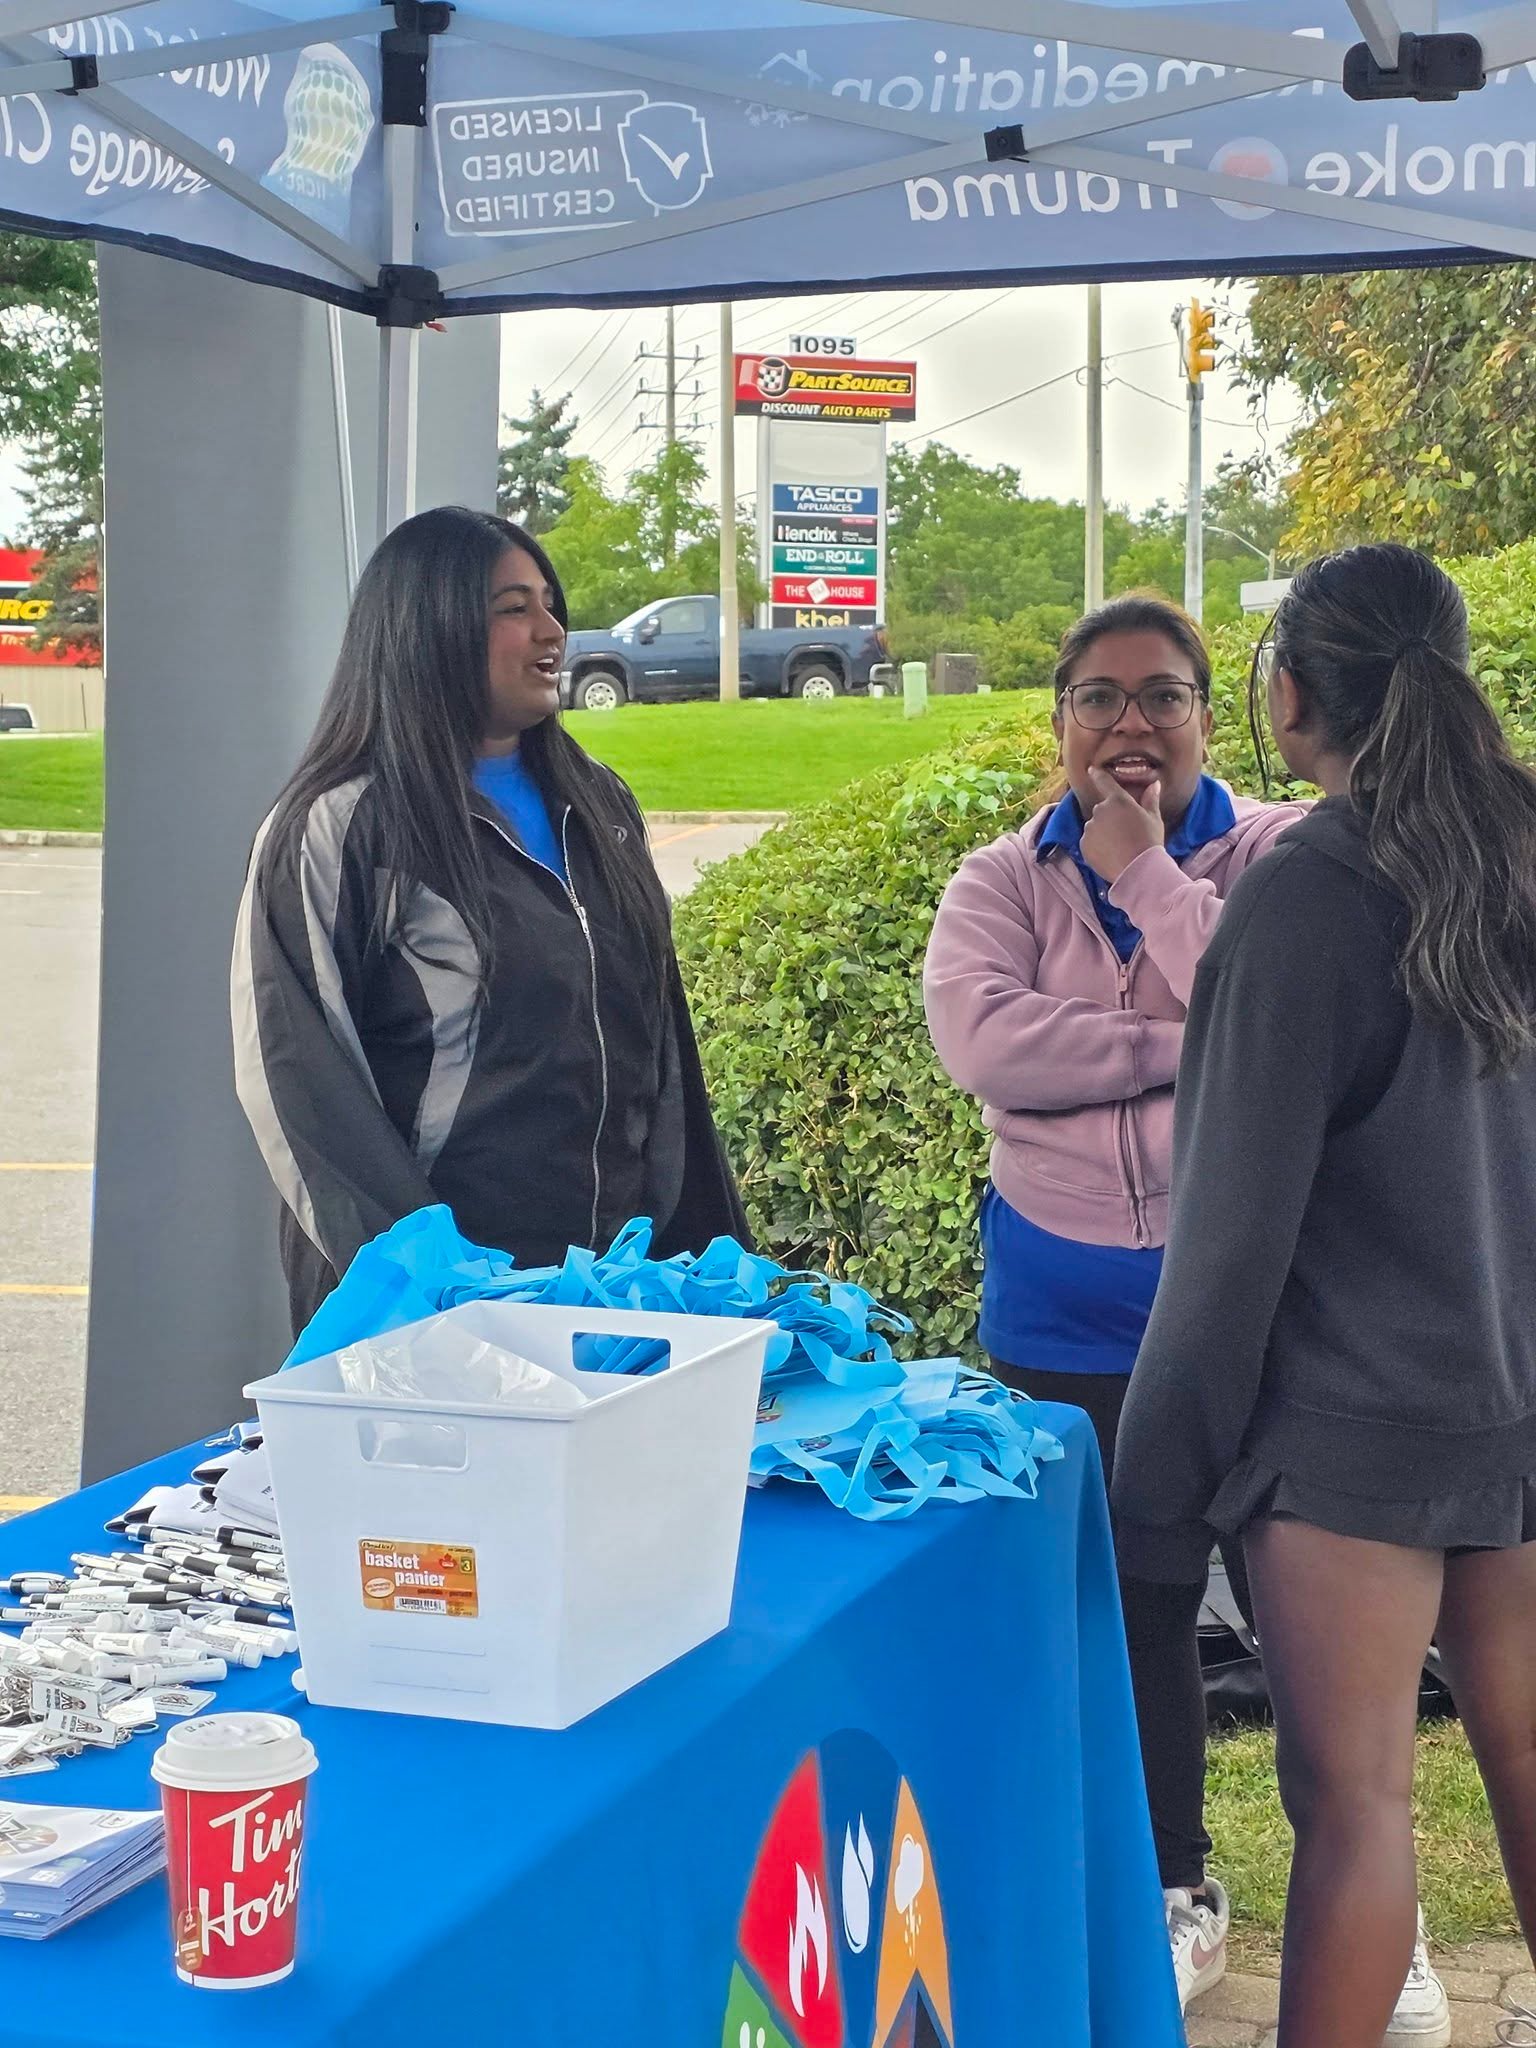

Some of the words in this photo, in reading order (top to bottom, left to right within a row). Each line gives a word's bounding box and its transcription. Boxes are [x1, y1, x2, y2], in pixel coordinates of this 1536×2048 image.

[791, 336, 855, 356] 1095
[761, 402, 821, 415] DISCOUNT
[821, 405, 854, 417] AUTO
[855, 407, 892, 418] PARTS
[788, 486, 863, 504] TASCO
[797, 502, 853, 512] APPLIANCES
[777, 525, 837, 543] Hendrix
[785, 549, 817, 562] END
[825, 550, 865, 564] ROLL
[784, 585, 805, 597] THE
[831, 587, 865, 599] HOUSE
[364, 1550, 420, 1570] basket
[394, 1571, 445, 1587] panier
[208, 1790, 302, 1873] Tim
[198, 1839, 303, 1956] Hort
